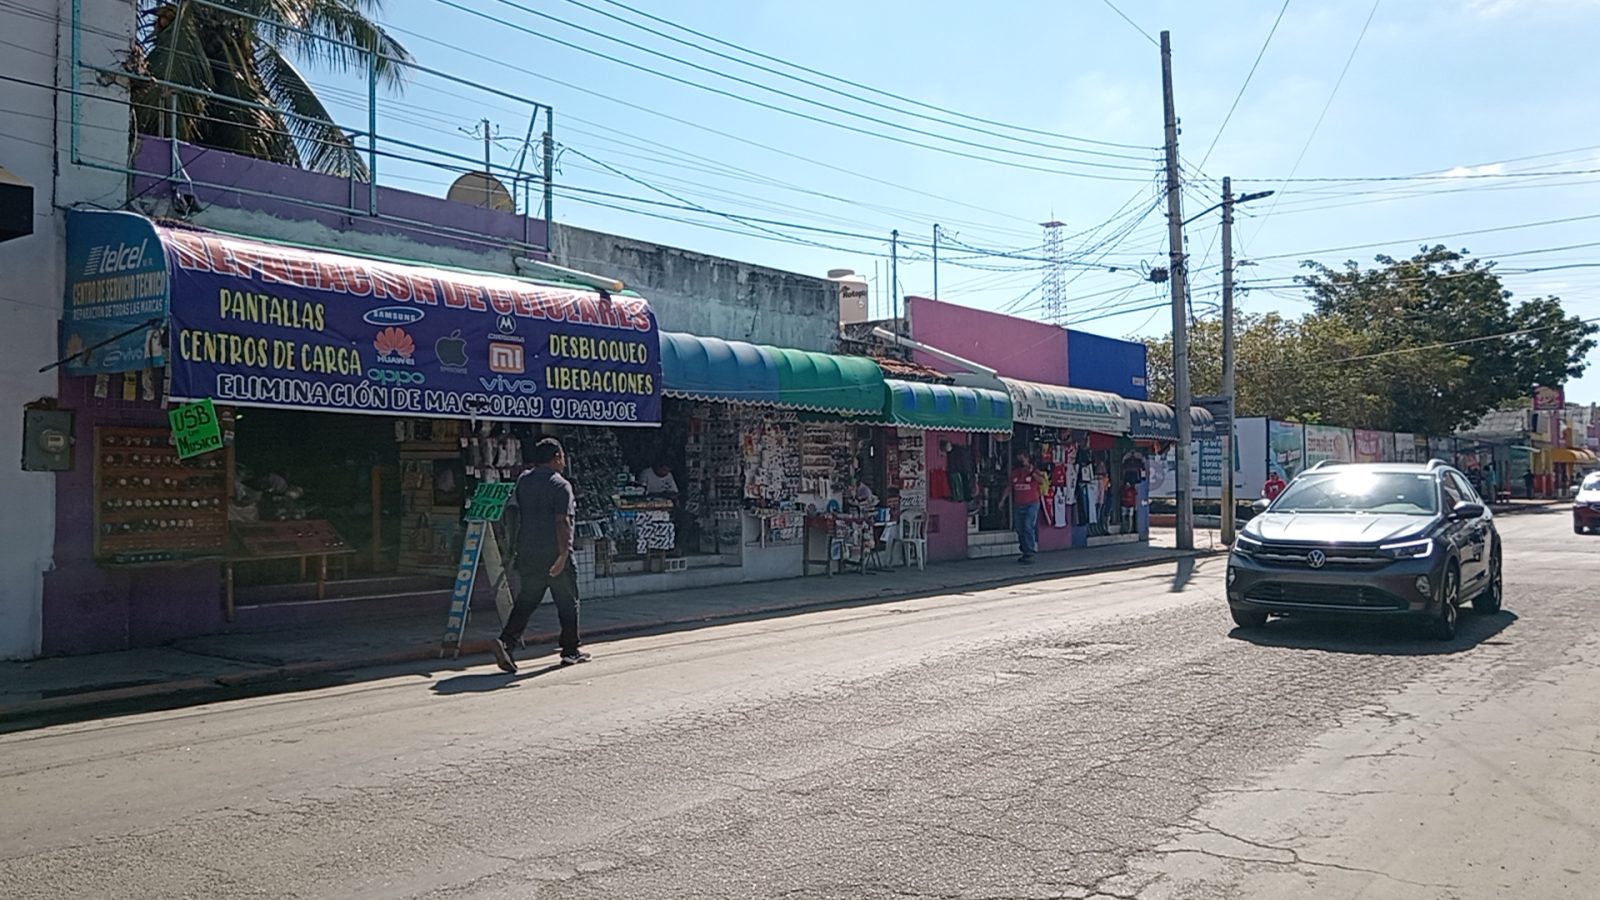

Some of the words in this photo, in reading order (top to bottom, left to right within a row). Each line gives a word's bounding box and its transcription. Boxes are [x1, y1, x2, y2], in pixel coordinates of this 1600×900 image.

[99, 238, 148, 274] telcel
[73, 281, 95, 306] CENTRO
[140, 299, 163, 314] MARCAS
[441, 279, 488, 312] DE
[489, 287, 650, 331] CELULARES
[219, 288, 325, 332] PANTALLAS
[373, 310, 417, 322] SAMSUNG
[179, 329, 268, 369] CENTROS
[273, 340, 296, 371] DE
[301, 343, 362, 377] CARGA
[377, 355, 416, 366] HUAWEI
[549, 334, 648, 365] DESBLOQUEO
[479, 374, 537, 394] vivo
[545, 366, 654, 396] LIBERACIONES
[216, 372, 388, 410] ELIMINACIÓN
[391, 388, 421, 411] DE
[424, 390, 544, 419] MACROPAY
[550, 397, 566, 419] Y
[567, 398, 638, 421] PAYJOE
[173, 405, 211, 432] USB
